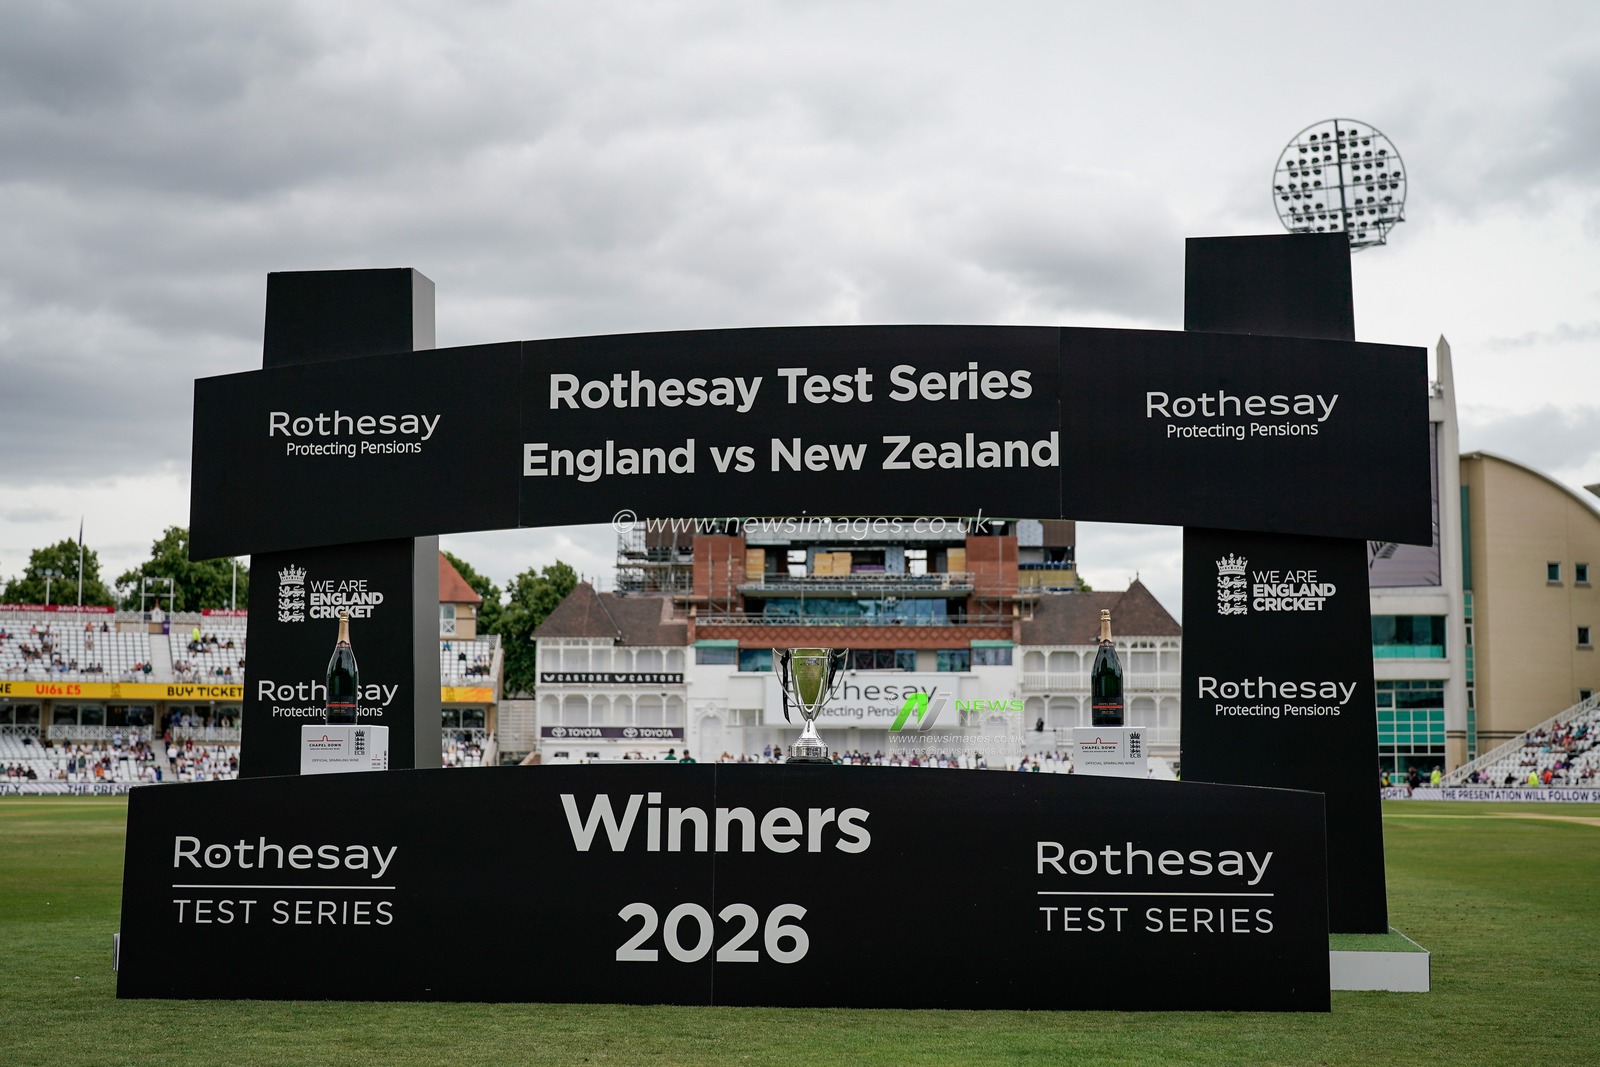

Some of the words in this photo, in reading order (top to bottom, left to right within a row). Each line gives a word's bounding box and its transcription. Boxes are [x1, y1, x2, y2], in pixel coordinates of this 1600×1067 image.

[550, 371, 762, 412] Rothesay
[778, 368, 872, 403] Test
[889, 362, 1033, 401] Series
[1147, 390, 1339, 422] Rothesay
[269, 411, 441, 440] Rothesay
[1167, 424, 1245, 440] Protecting
[1250, 422, 1318, 436] Pensions
[286, 442, 356, 458] Protecting
[361, 441, 421, 454] Pensions
[524, 438, 694, 482] England
[710, 445, 755, 472] vs
[772, 438, 867, 471] New
[883, 431, 1060, 470] Zealand
[1253, 571, 1280, 584] WE
[1284, 570, 1317, 583] ARE
[310, 581, 334, 592] WE
[338, 580, 367, 592] ARE
[1253, 583, 1336, 597] ENGLAND
[310, 592, 384, 605] ENGLAND
[1253, 597, 1326, 611] CRICKET
[310, 605, 374, 618] CRICKET
[557, 674, 610, 682] CASTORE
[629, 674, 681, 682] CASTORE
[66, 684, 81, 695] £5
[167, 686, 194, 697] BUY
[197, 686, 243, 697] TICKET
[258, 680, 398, 706] Rothay
[787, 681, 937, 706] thesay
[1199, 677, 1357, 705] Rothesay
[355, 705, 383, 717] sions
[822, 706, 863, 719] tecting
[1215, 704, 1280, 719] Protecting
[1284, 703, 1340, 716] Pensions
[568, 728, 602, 737] TOYOTA
[640, 729, 673, 737] TOYOTA
[68, 785, 90, 793] THE
[1442, 790, 1456, 799] THE
[1459, 790, 1521, 799] PRESENTATION
[1524, 790, 1546, 800] WILL
[1549, 790, 1589, 800] FOLLOW
[560, 792, 871, 854] Winners
[173, 836, 398, 879] Rothesay
[1037, 842, 1274, 886] Rothesay
[173, 900, 257, 924] TEST
[272, 901, 393, 926] SERIES
[1040, 907, 1128, 932] TEST
[1145, 908, 1274, 933] SERIES
[615, 902, 810, 963] 2026
